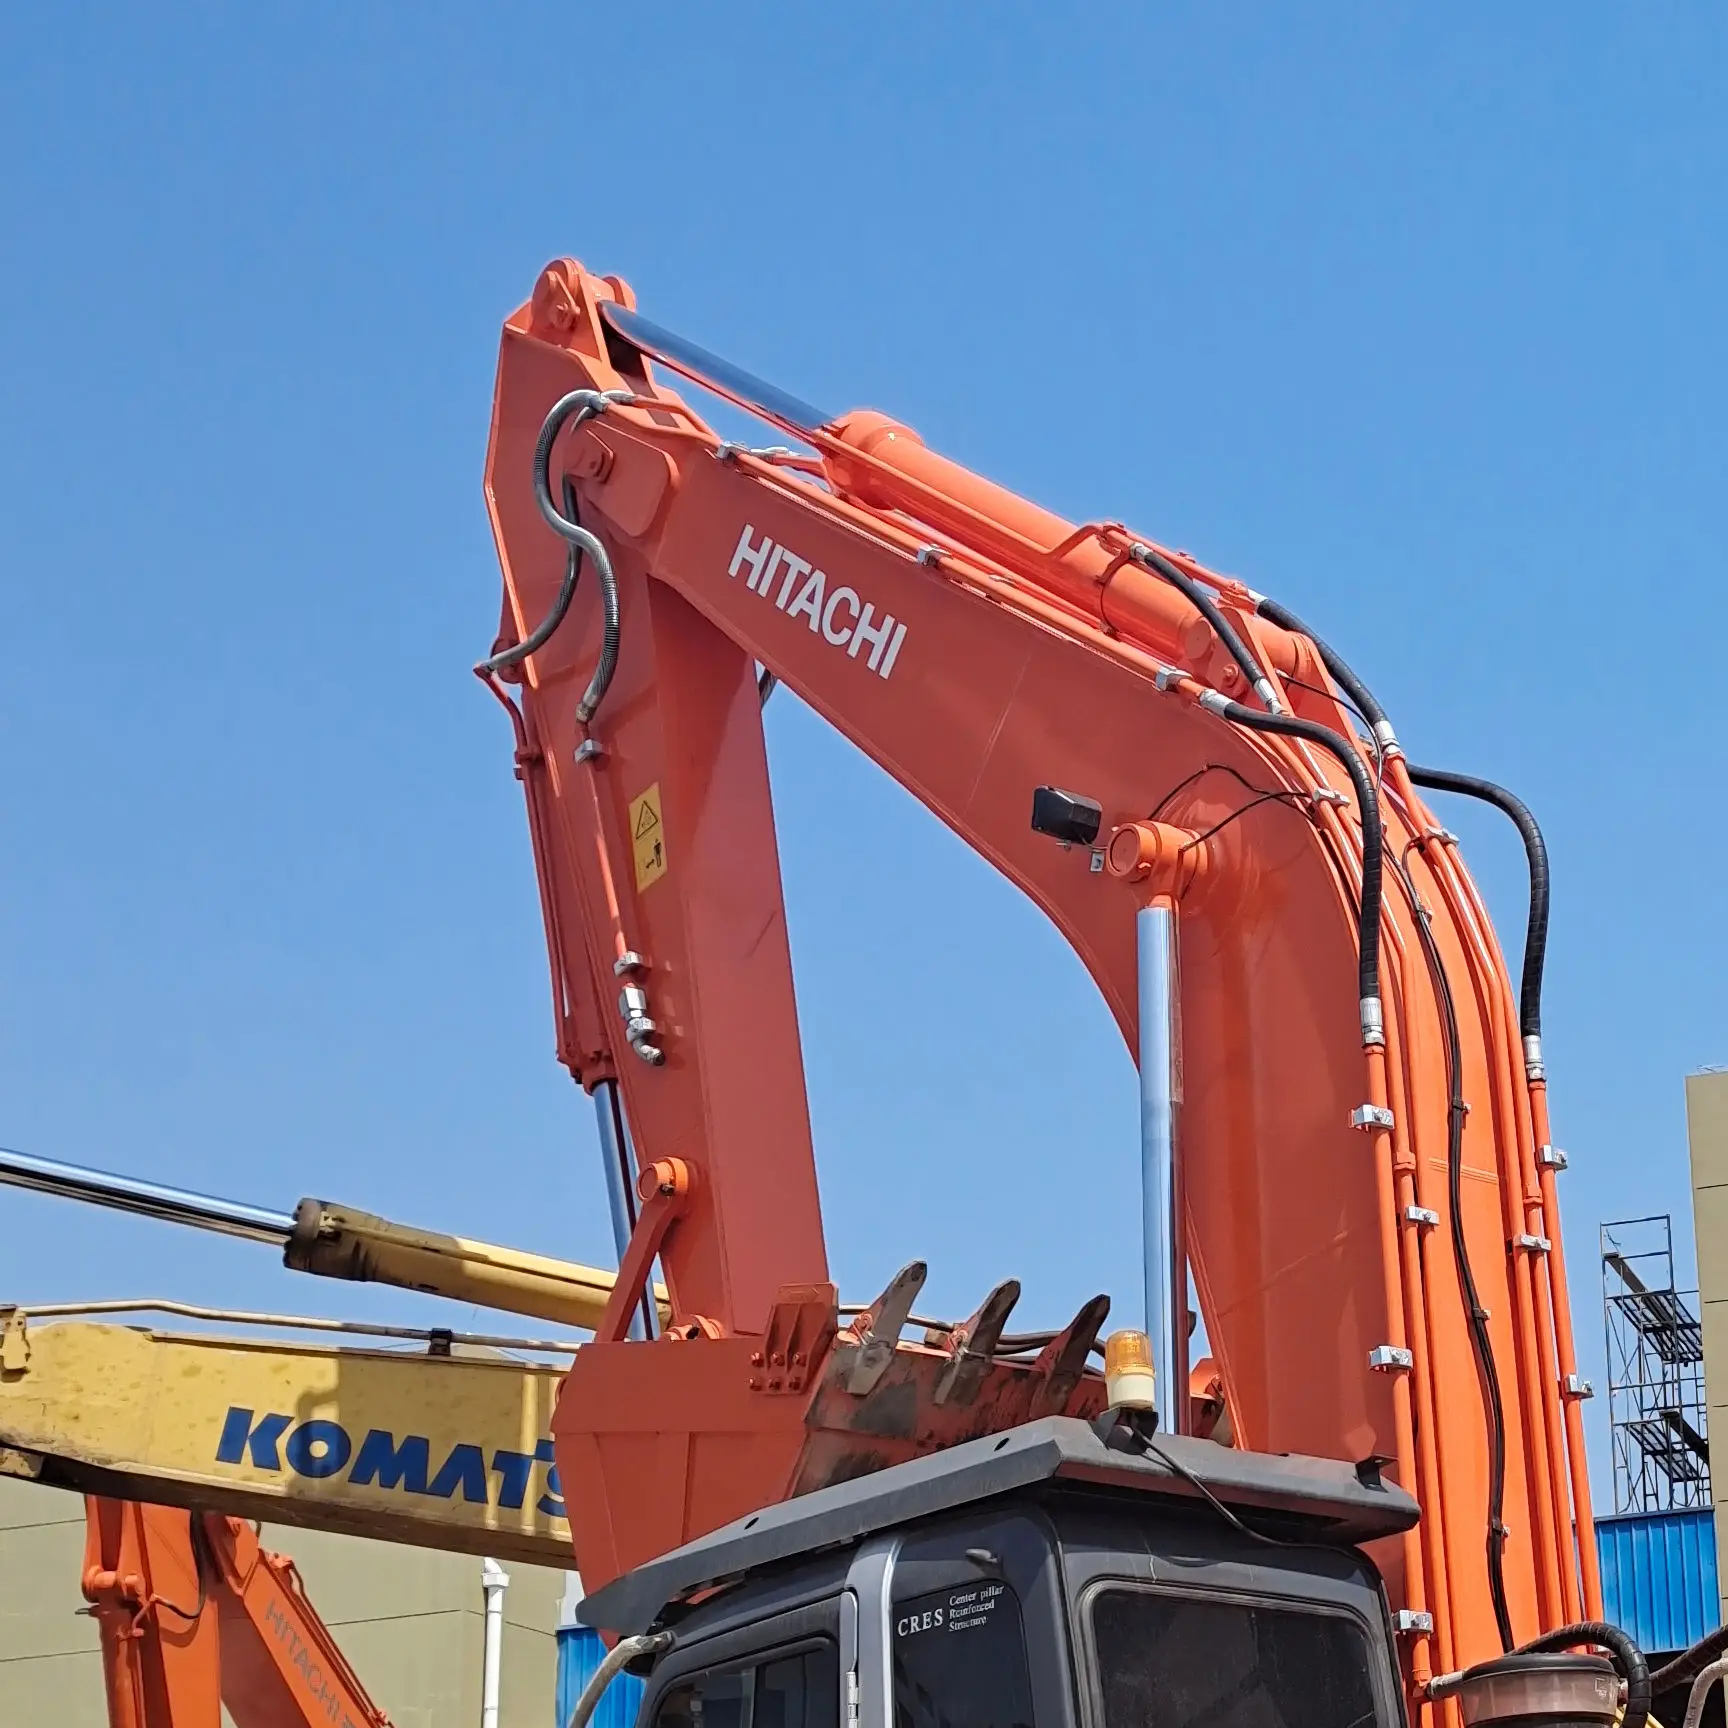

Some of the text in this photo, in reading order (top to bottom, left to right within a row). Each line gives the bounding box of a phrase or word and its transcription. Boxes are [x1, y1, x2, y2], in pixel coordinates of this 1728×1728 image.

[728, 523, 908, 680] HITACHI
[898, 1608, 943, 1637] CRES
[949, 1585, 1005, 1606] Center pillar
[264, 1598, 341, 1723] HITACHI
